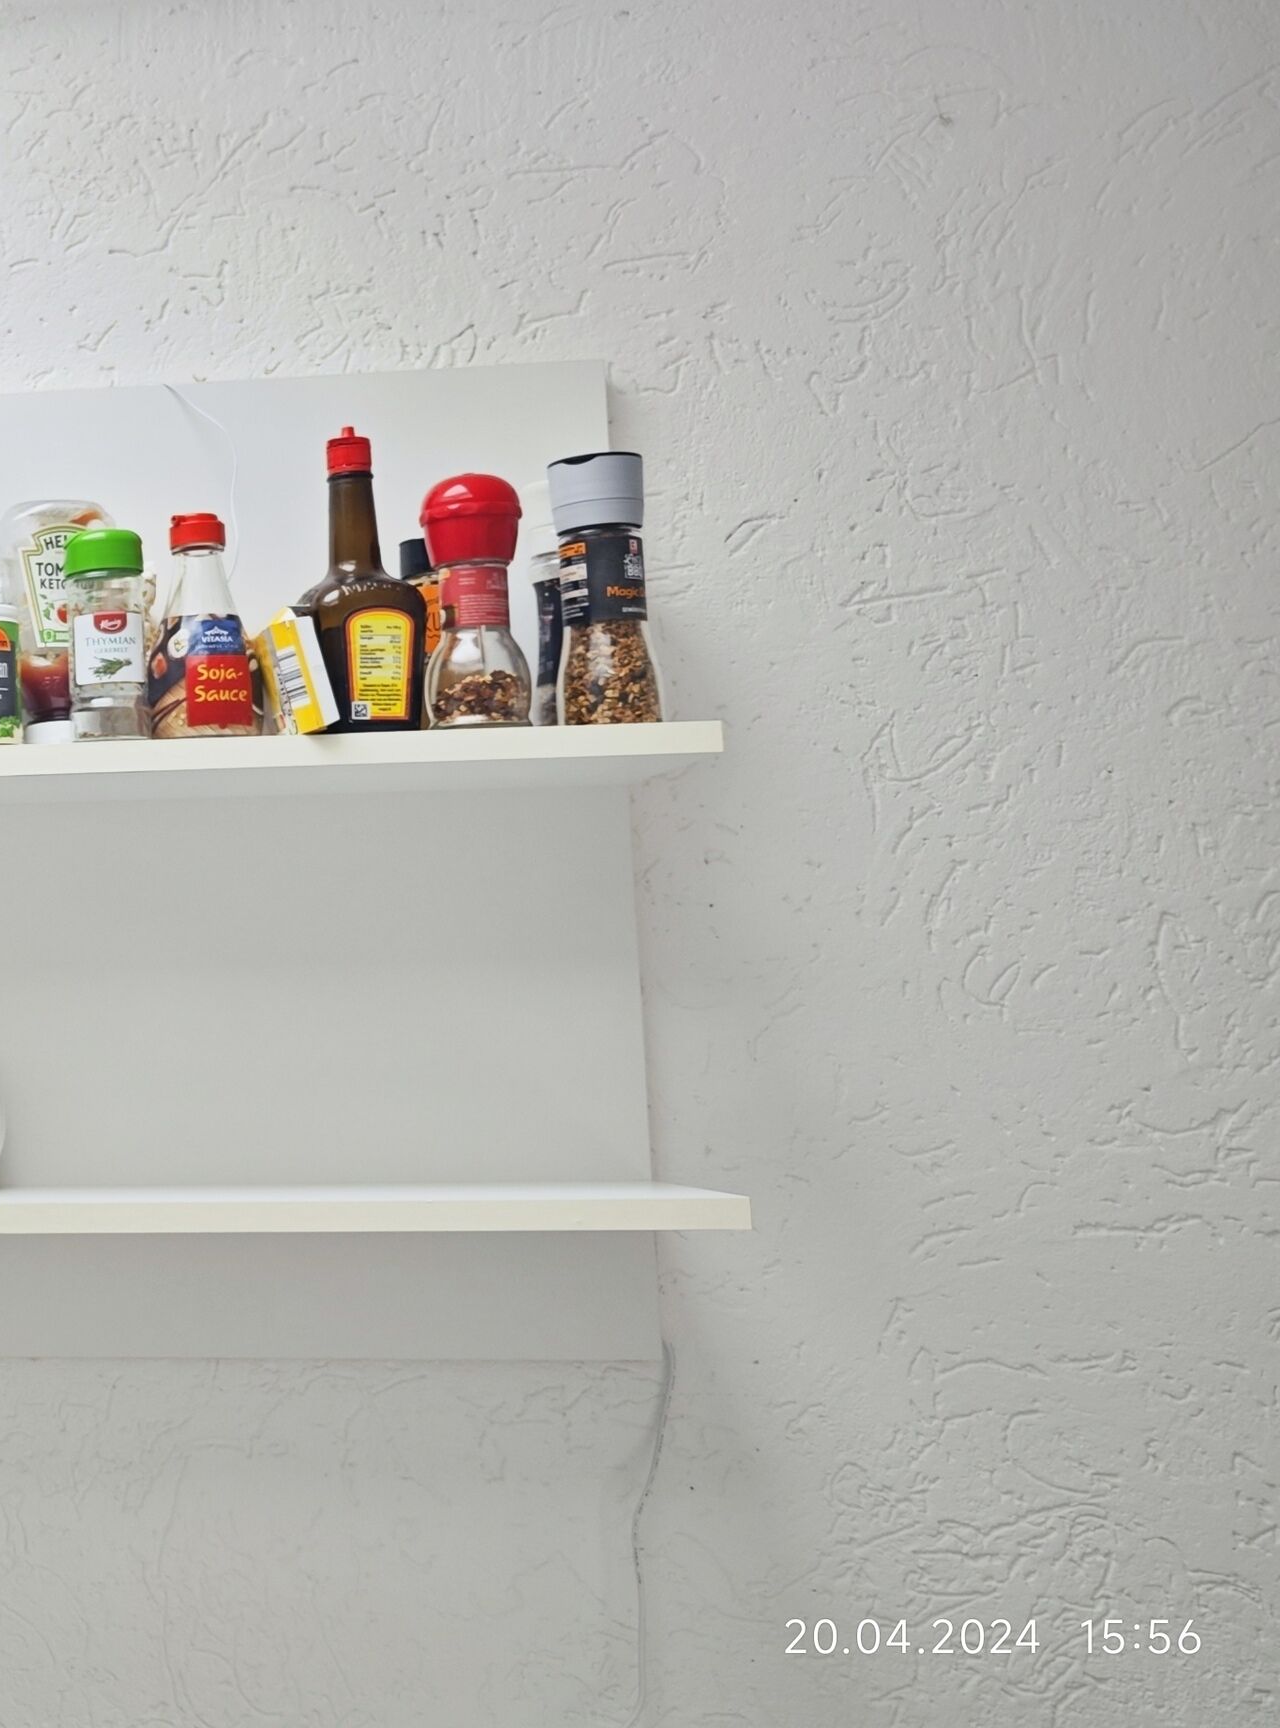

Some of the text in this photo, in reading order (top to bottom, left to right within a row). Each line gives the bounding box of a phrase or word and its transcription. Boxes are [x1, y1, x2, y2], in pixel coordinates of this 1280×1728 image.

[35, 562, 64, 577] TOM
[85, 636, 136, 647] THYMIAN
[201, 635, 234, 643] VITASIA
[196, 663, 244, 683] Soja-
[194, 685, 248, 702] Sauce
